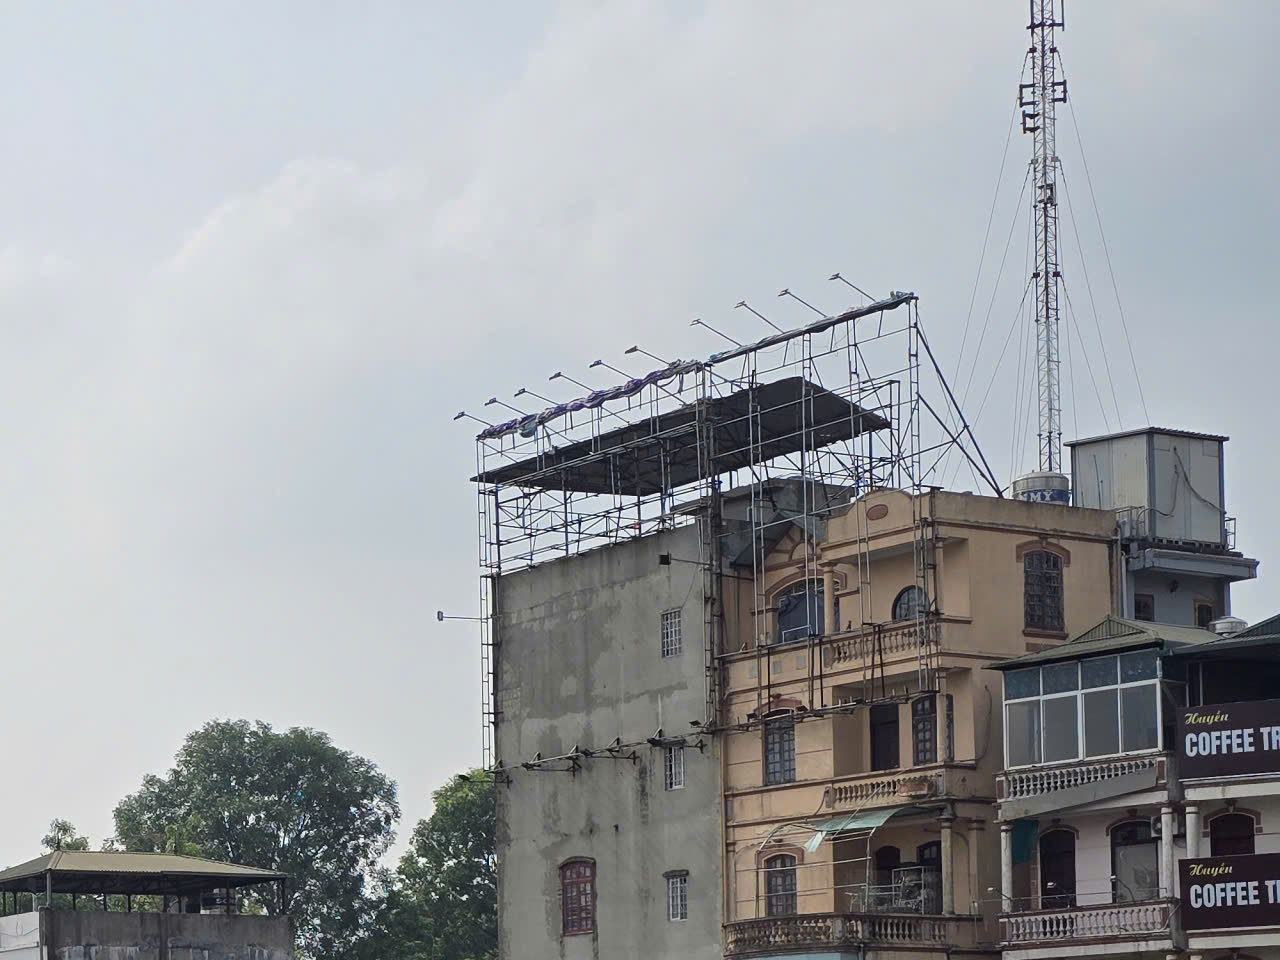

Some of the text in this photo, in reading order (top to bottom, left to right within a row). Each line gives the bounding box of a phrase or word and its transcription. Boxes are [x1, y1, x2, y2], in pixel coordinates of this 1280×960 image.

[1185, 728, 1255, 757] COFFEE
[1190, 880, 1280, 908] COFFEE T
